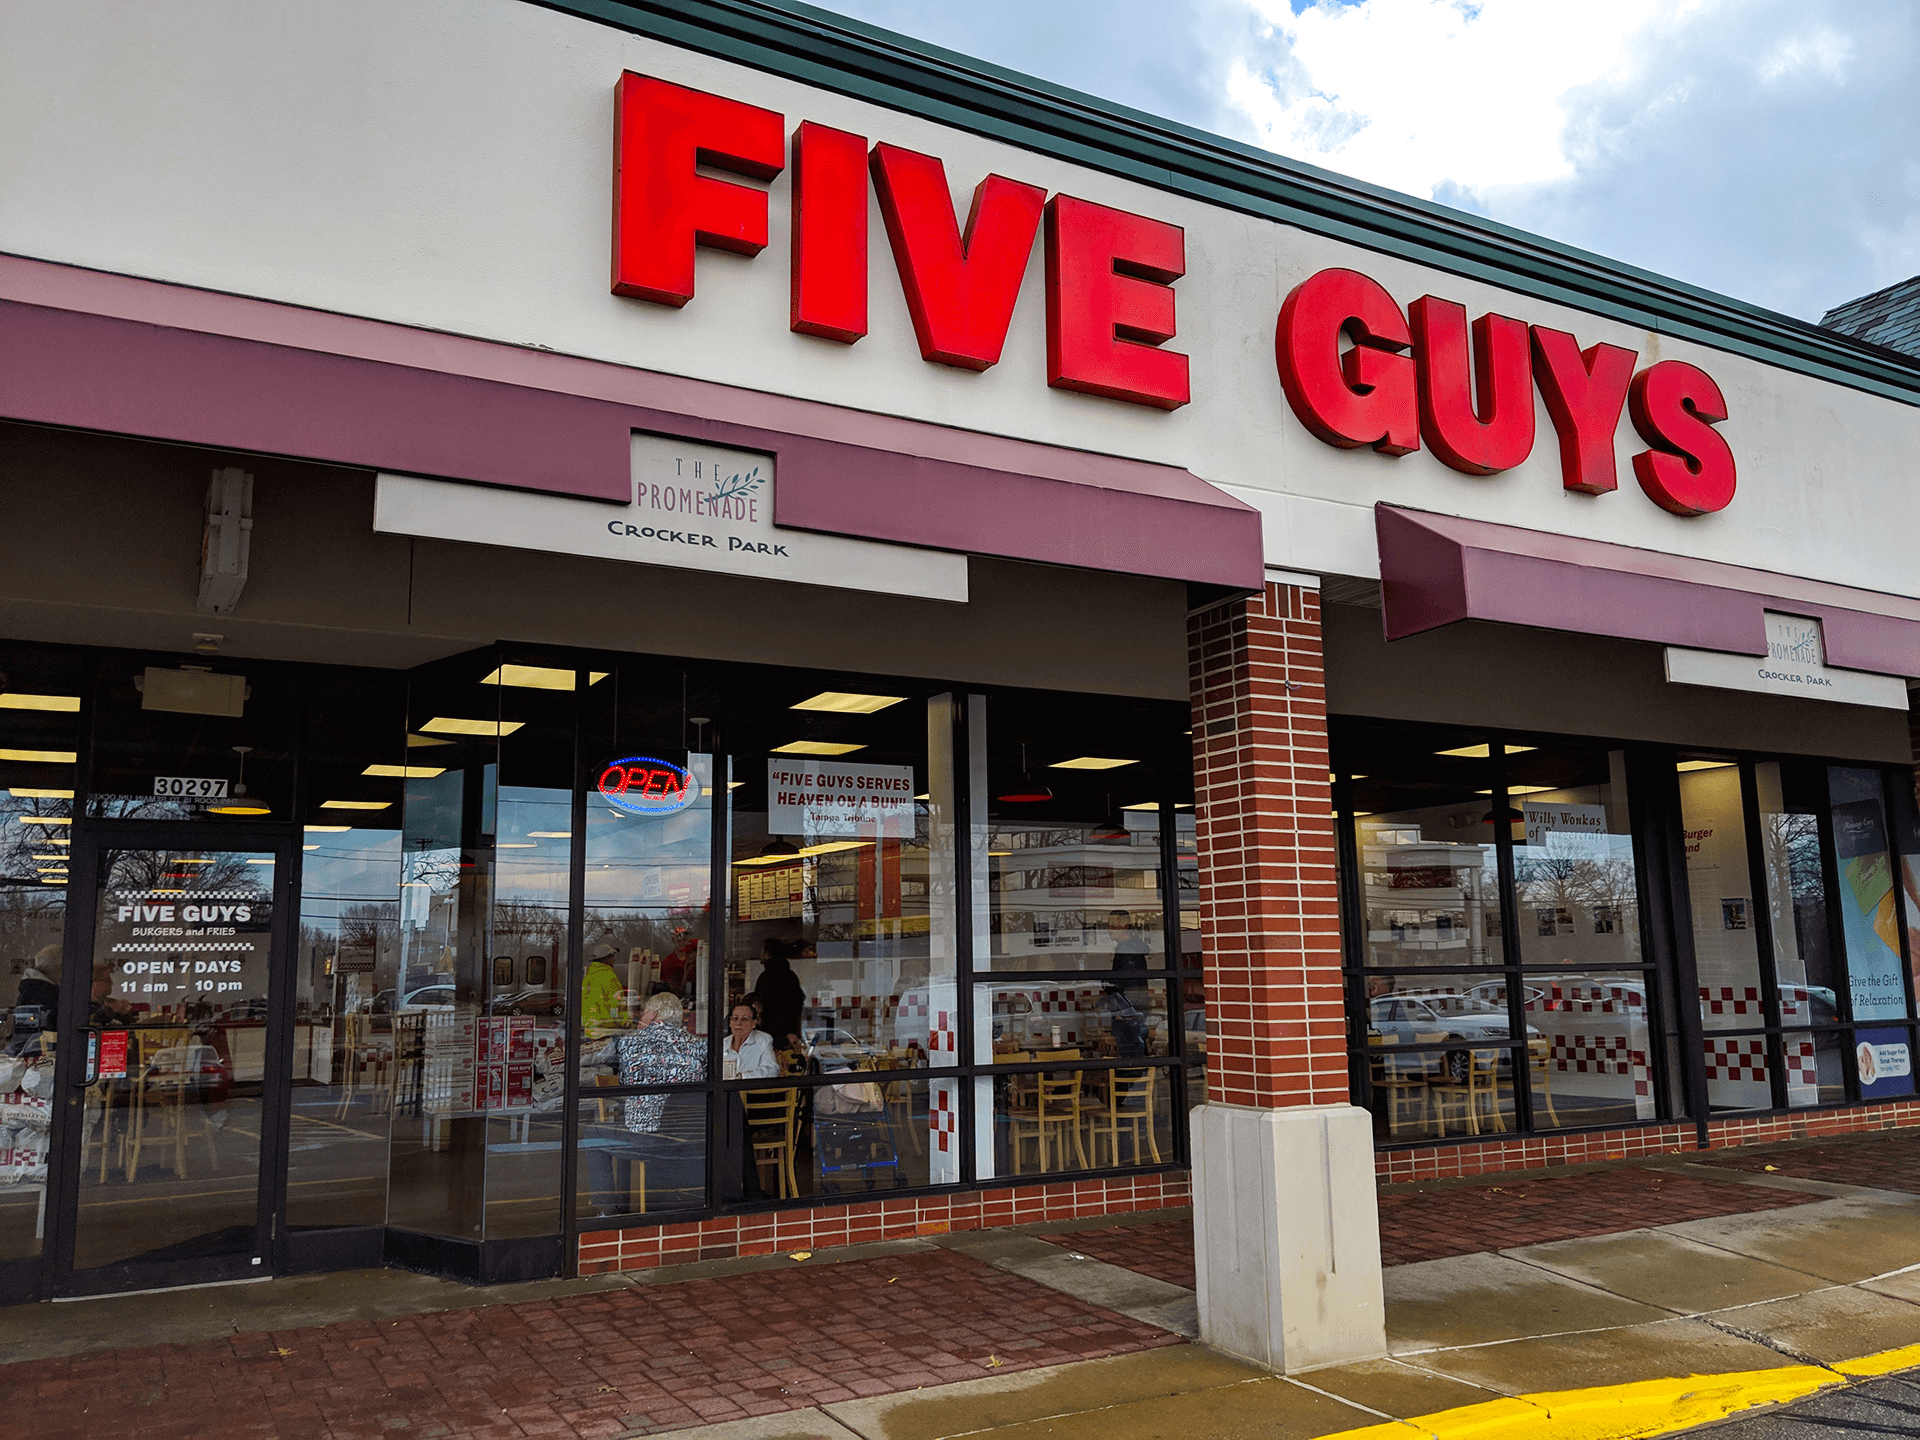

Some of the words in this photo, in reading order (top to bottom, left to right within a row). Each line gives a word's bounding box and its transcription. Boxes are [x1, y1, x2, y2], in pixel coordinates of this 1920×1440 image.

[611, 68, 1191, 412] FIVE
[1275, 267, 1737, 517] GUYS
[676, 457, 720, 483] THE
[638, 481, 759, 524] PROMENADE
[1779, 624, 1798, 640] THE
[156, 778, 227, 797] 30297
[599, 765, 692, 803] OPEN
[816, 773, 854, 789] GUYS
[856, 775, 910, 791] SERVES
[777, 791, 834, 806] HEAVEN
[837, 794, 856, 808] ON
[858, 795, 867, 808] A
[1560, 812, 1602, 827] Wonkas
[1528, 825, 1541, 843] of
[118, 905, 175, 922] FIVE
[182, 905, 252, 922] GUYS
[132, 927, 184, 936] BURGERS
[185, 927, 204, 936] and
[206, 927, 236, 936] FRIES
[122, 961, 175, 974] OPEN
[179, 962, 191, 974] 7
[194, 960, 242, 973] DAYS
[120, 981, 137, 993] 11
[142, 983, 169, 992] am
[195, 980, 214, 991] 10
[217, 981, 243, 993] pm
[1849, 974, 1867, 987] Give
[1868, 974, 1881, 987] the
[1882, 973, 1899, 986] Gift
[1859, 993, 1904, 1007] Relaxation
